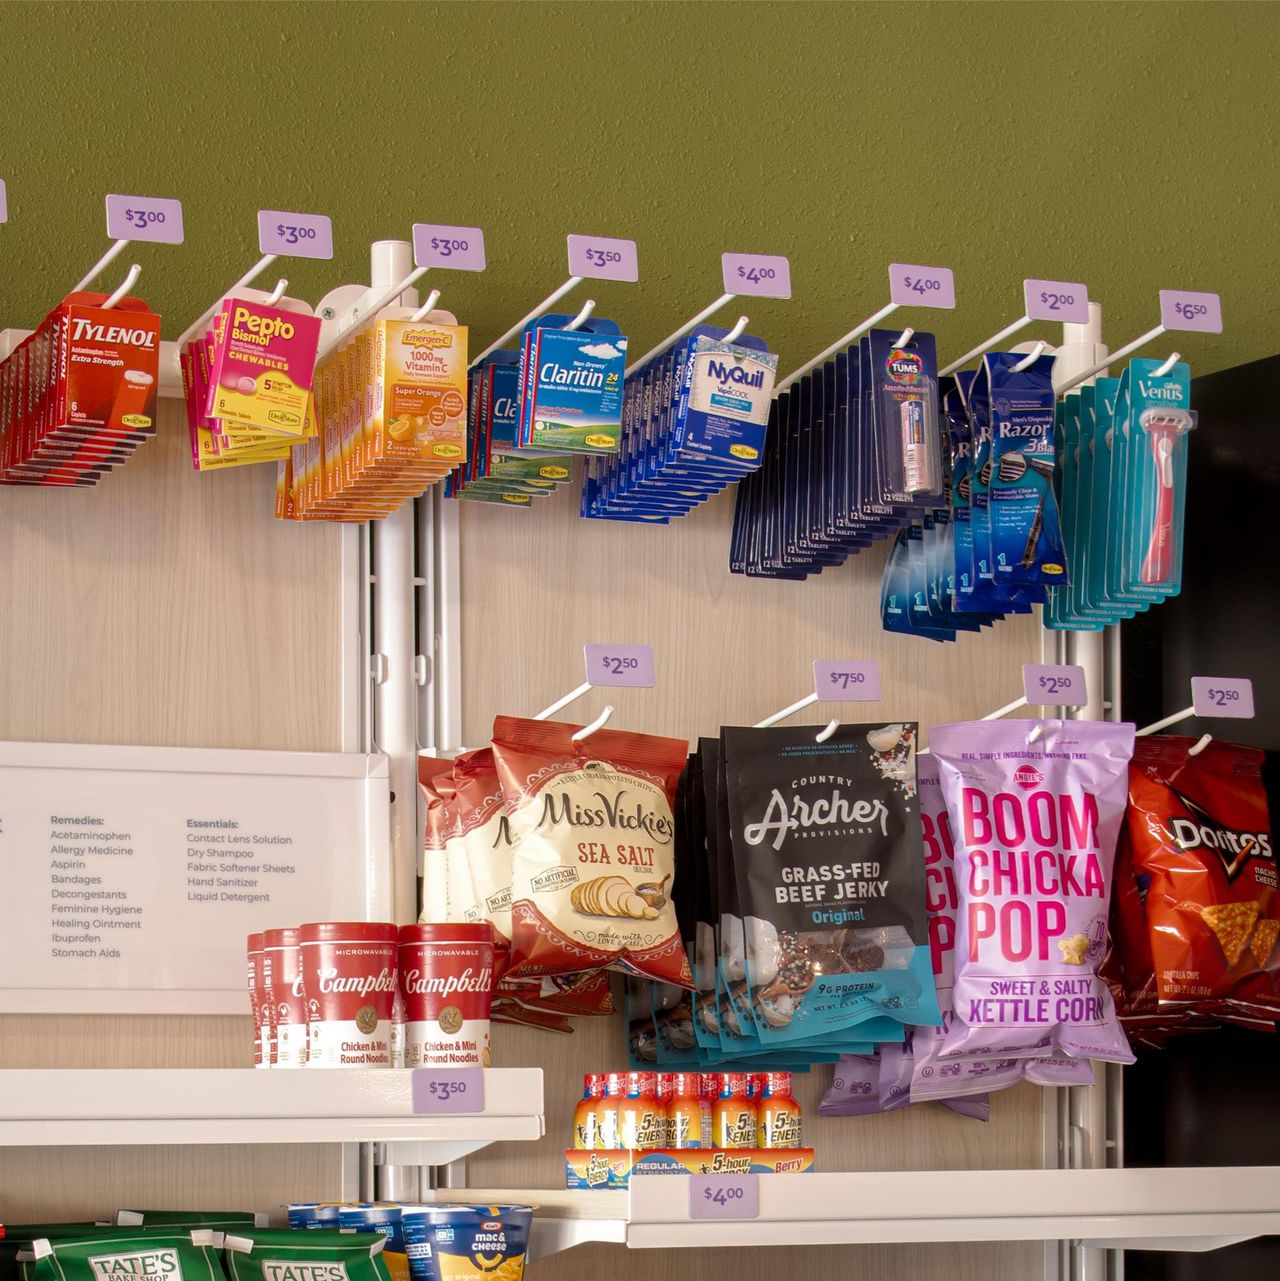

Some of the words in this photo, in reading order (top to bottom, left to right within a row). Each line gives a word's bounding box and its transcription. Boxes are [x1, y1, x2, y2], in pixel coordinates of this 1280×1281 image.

[234, 306, 295, 340] Pepto
[72, 318, 156, 348] TYLENOL
[231, 328, 270, 347] Bismol
[228, 351, 289, 372] CHEWABLES
[891, 363, 919, 375] TUMS
[540, 362, 603, 388] Claritin
[708, 359, 764, 390] NyQuil
[1138, 380, 1184, 401] Venus
[1000, 422, 1051, 440] Razor
[791, 775, 853, 789] COUNTRY
[50, 815, 104, 826] Remedies:
[186, 818, 239, 830] Essentials:
[538, 792, 592, 827] Miss
[592, 790, 675, 845] Vickie's
[743, 788, 890, 850] Archer
[962, 787, 1101, 851] BOOM
[50, 830, 131, 842] Acetaminophen
[186, 834, 225, 844] Contact
[227, 834, 250, 845] Lens
[252, 835, 292, 845] Solution
[794, 827, 873, 839] PROVISIONS
[1170, 818, 1273, 857] Doritos
[51, 845, 86, 857] Allergy
[88, 846, 133, 856] Medicine
[187, 848, 205, 859] Dry
[206, 848, 254, 860] Shampoo
[577, 842, 611, 865] SEA
[617, 846, 655, 867] SALT
[51, 860, 86, 871] Aspirin
[187, 863, 217, 873] Fabric
[219, 863, 261, 873] Softener
[262, 863, 295, 874] Sheets
[781, 861, 880, 884] GRASS-FED
[51, 874, 102, 886] Bandages
[187, 877, 214, 887] Hand
[216, 877, 258, 888] Sanitizer
[967, 850, 1105, 899] CHICKA
[51, 889, 127, 901] Decongestants
[187, 892, 218, 903] Liquid
[220, 892, 270, 903] Detergent
[775, 883, 826, 904] BEEF
[833, 880, 889, 900] JERKY
[51, 904, 99, 914] Feminine
[101, 905, 142, 916] Hygiene
[812, 907, 865, 925] Original
[51, 919, 90, 931] Healing
[92, 919, 141, 929] Ointment
[967, 899, 1067, 963] POP
[51, 933, 101, 945] Ibuprofen
[51, 948, 97, 958] Stomach
[98, 948, 121, 958] Aids
[404, 967, 492, 998] Campbell's
[968, 998, 1049, 1023] KETTLE
[1055, 996, 1105, 1022] CORN
[636, 1162, 685, 1170] REGULAR
[774, 1158, 803, 1173] Berry
[94, 1252, 177, 1276] TATE'S
